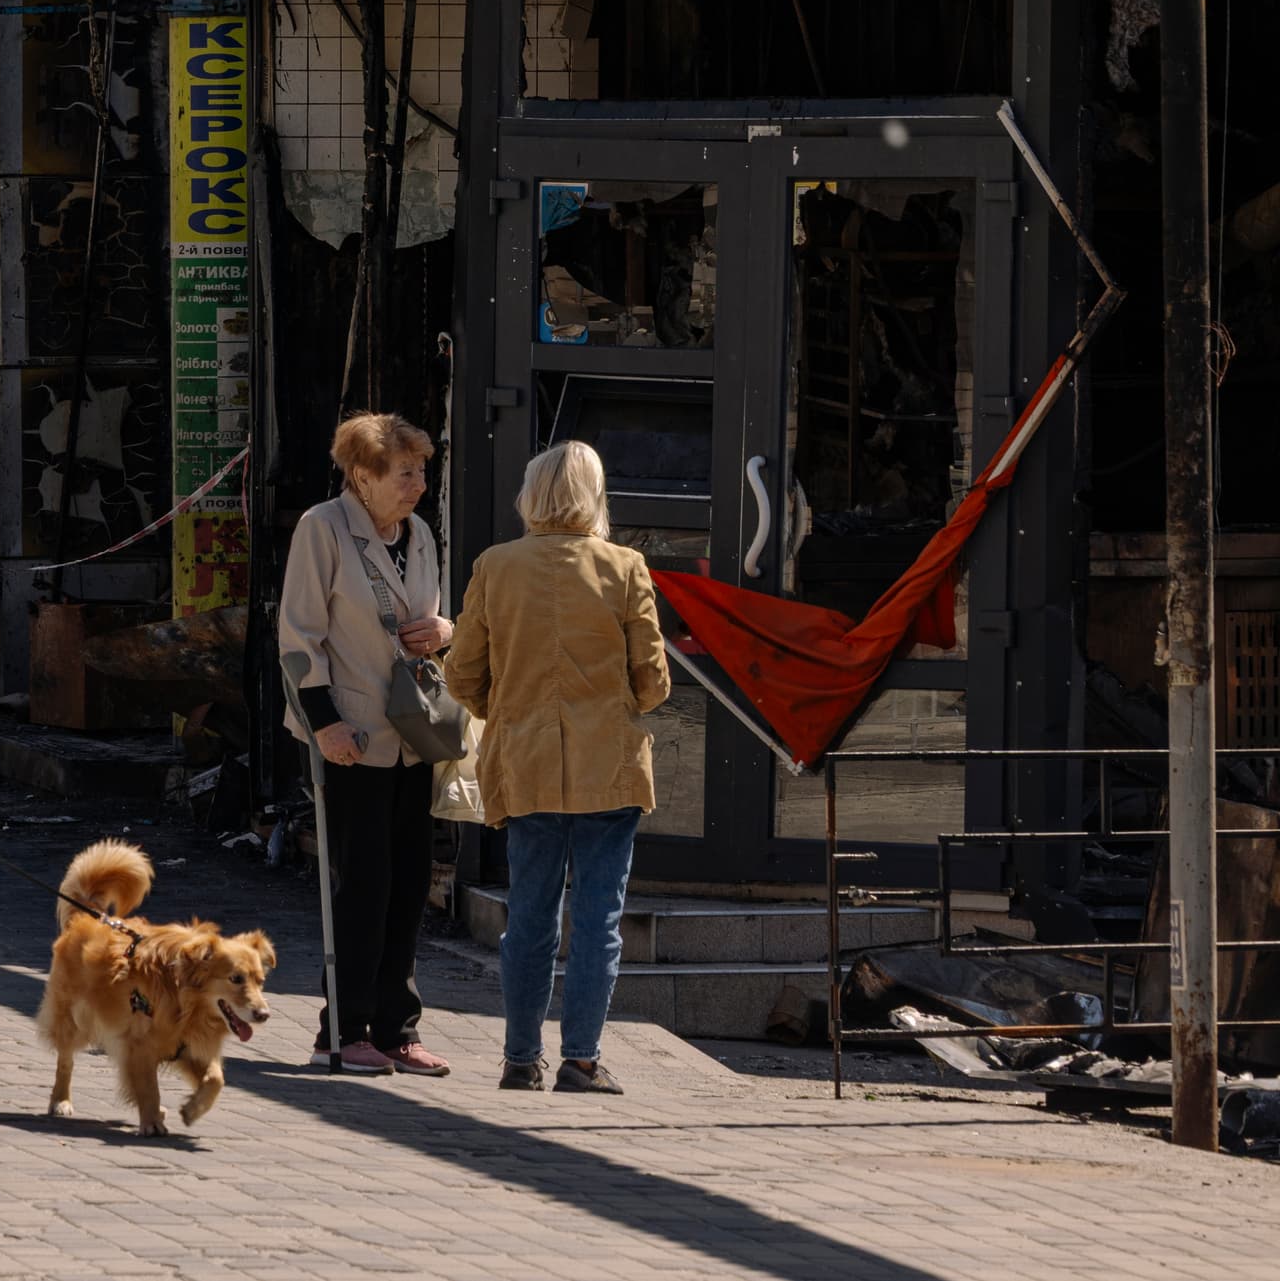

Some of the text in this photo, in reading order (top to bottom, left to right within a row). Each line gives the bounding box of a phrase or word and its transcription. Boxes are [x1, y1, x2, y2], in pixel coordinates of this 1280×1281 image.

[186, 22, 247, 234] КСЕРОКС
[178, 244, 198, 255] 2-й
[175, 322, 221, 333] Золото
[176, 392, 226, 405] Монети
[176, 428, 243, 443] Нагороди
